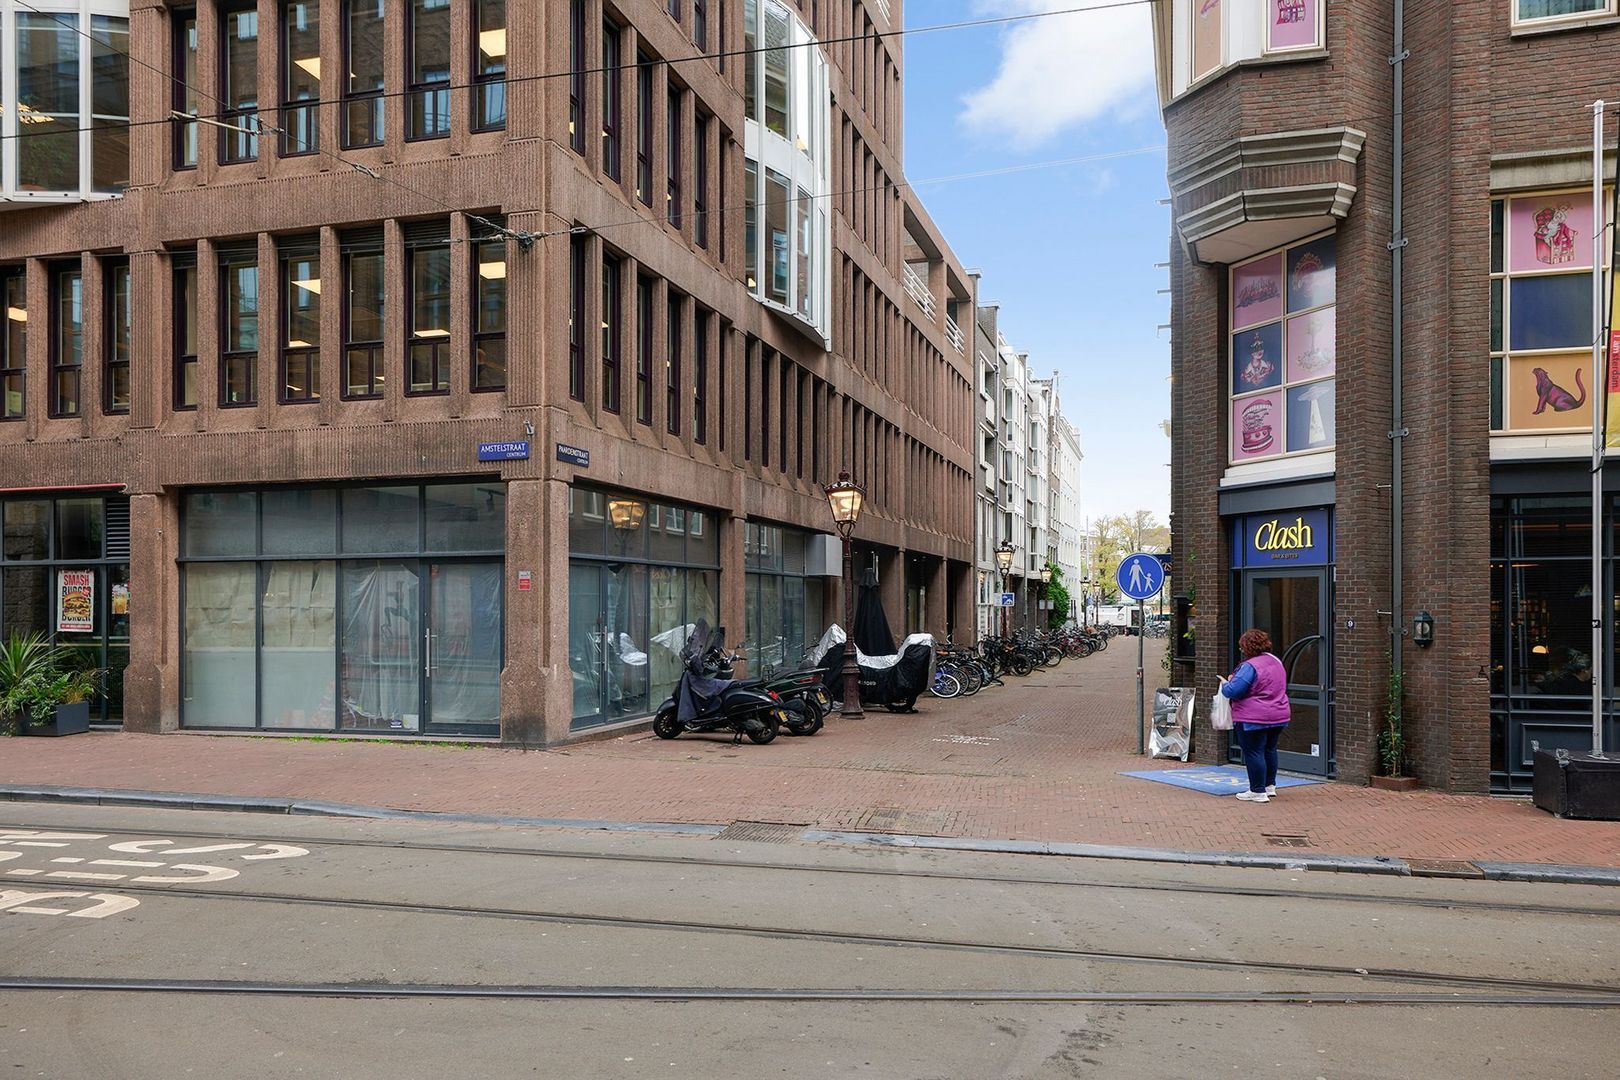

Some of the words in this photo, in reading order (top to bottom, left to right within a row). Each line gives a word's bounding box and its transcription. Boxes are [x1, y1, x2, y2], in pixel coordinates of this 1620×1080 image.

[480, 443, 526, 453] AMSTELSTRAAT
[1254, 517, 1314, 551] Clash
[63, 574, 90, 586] SMASH
